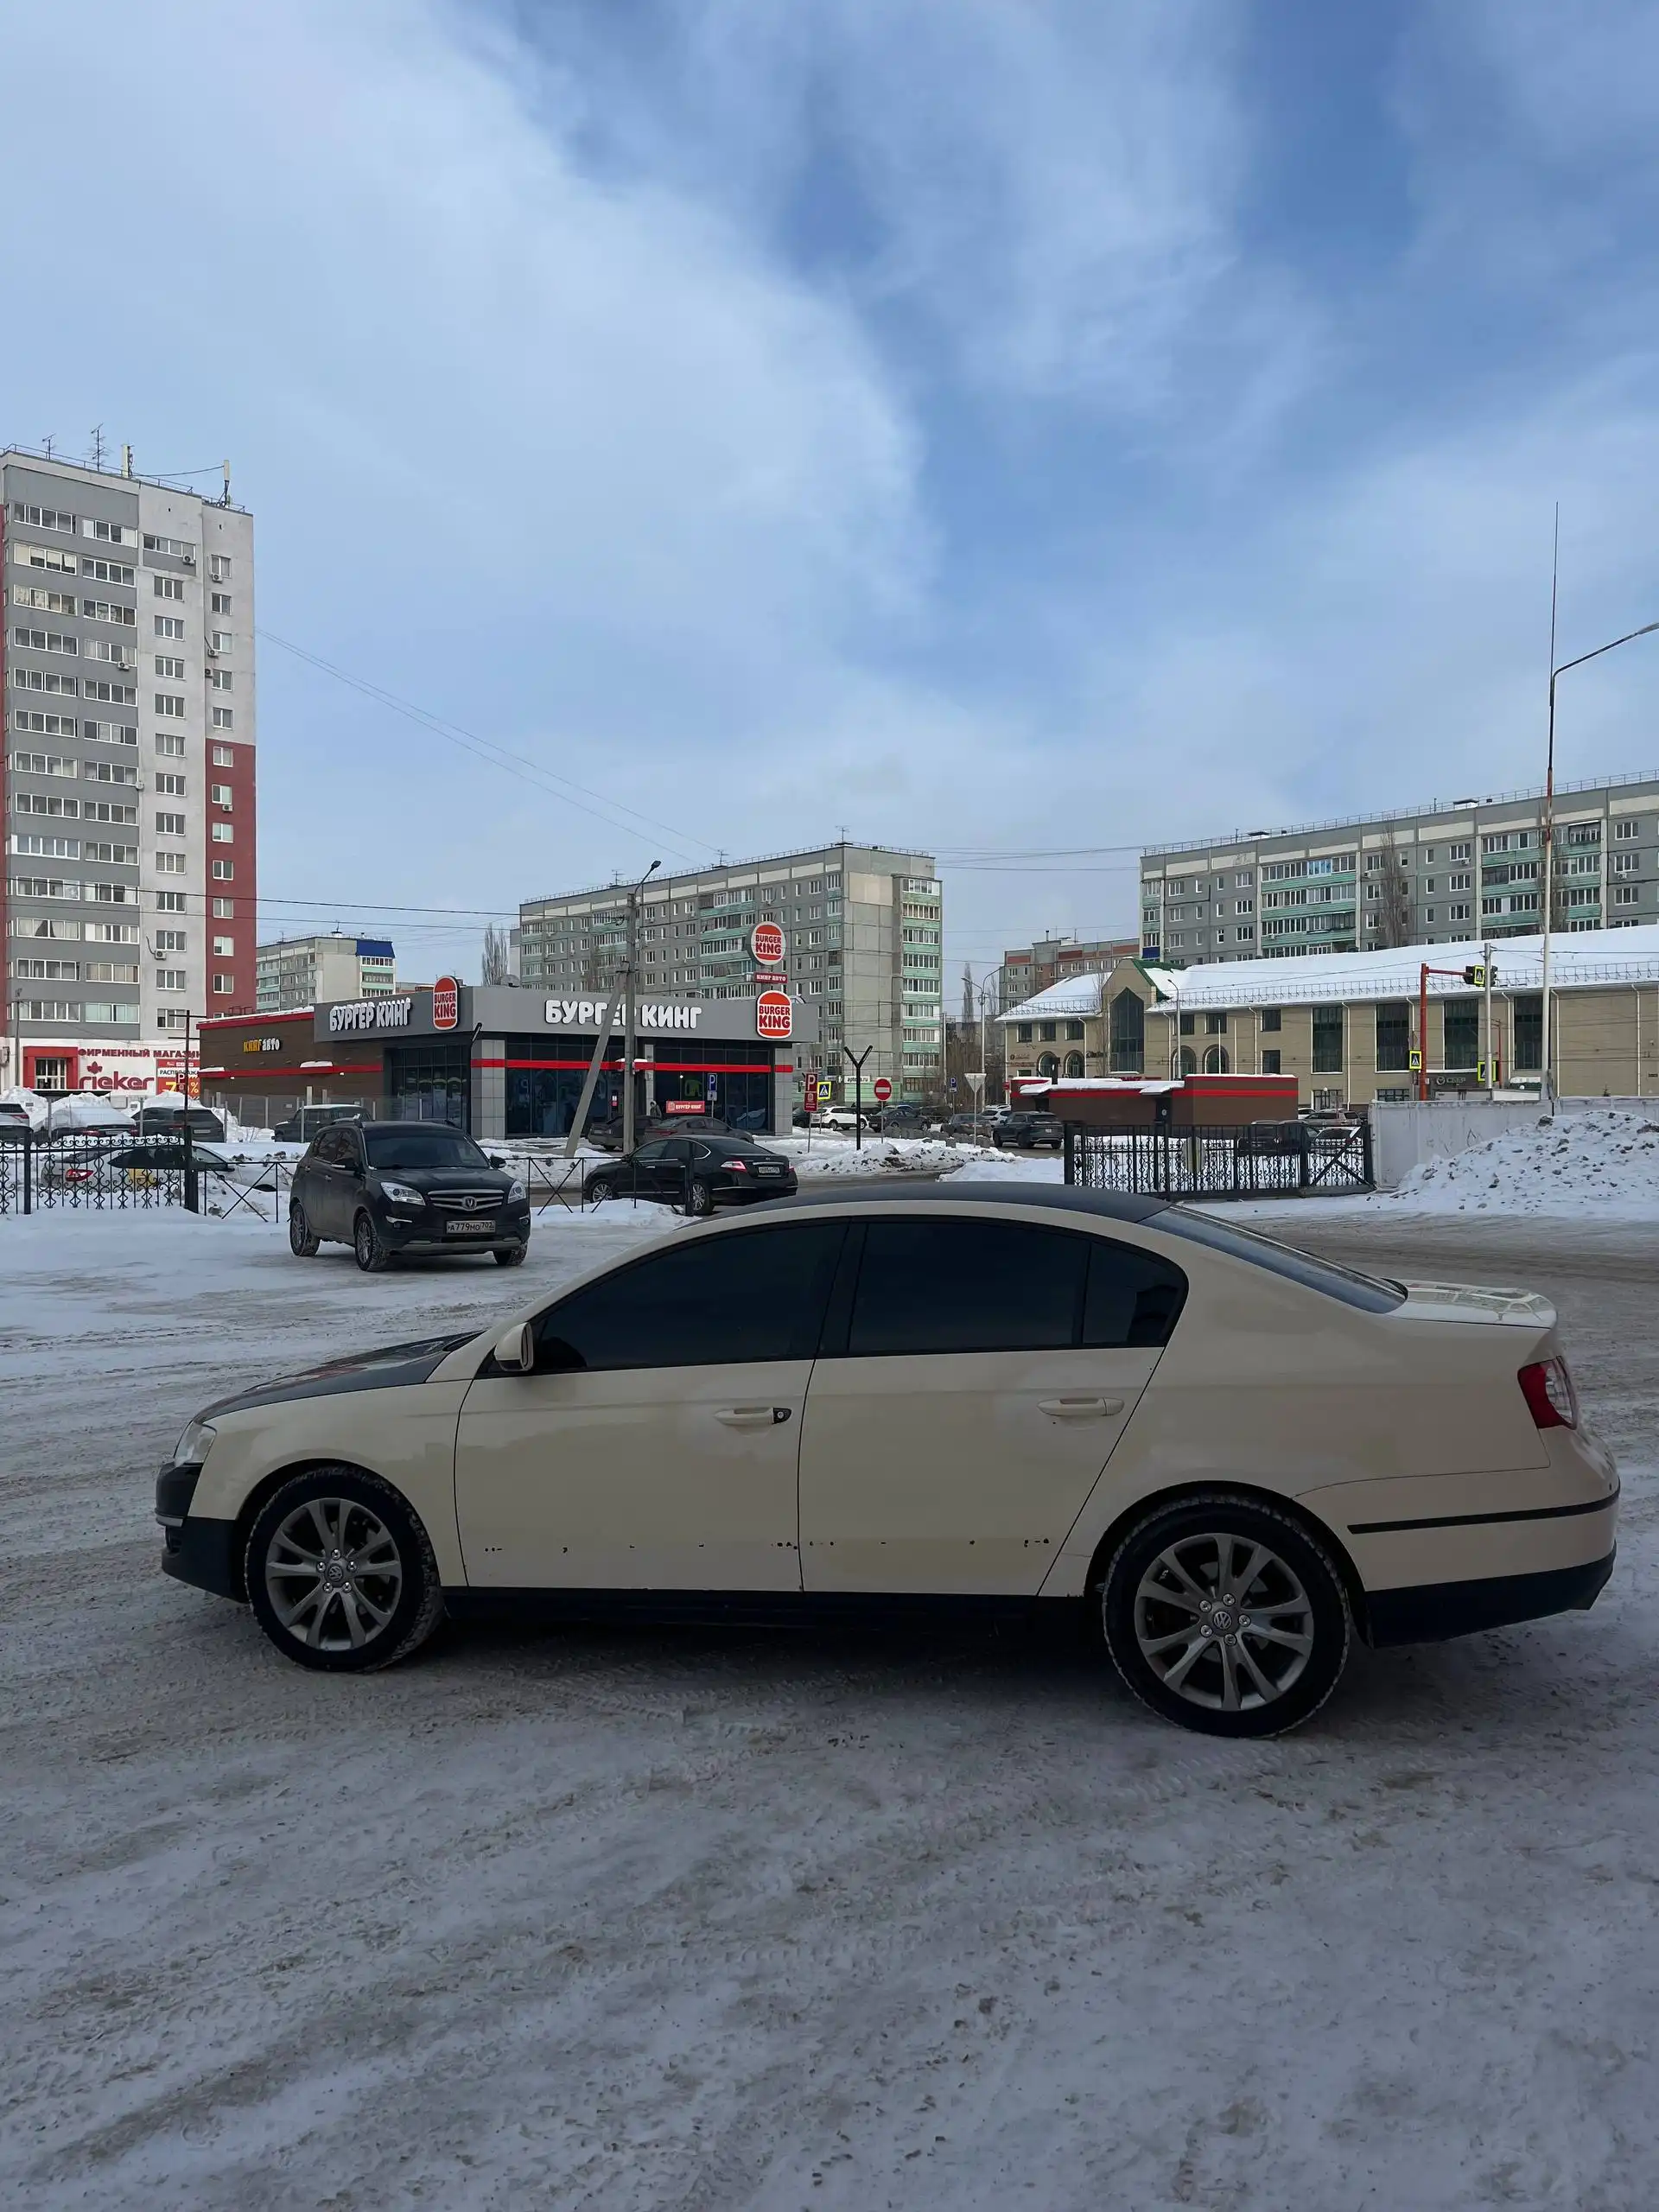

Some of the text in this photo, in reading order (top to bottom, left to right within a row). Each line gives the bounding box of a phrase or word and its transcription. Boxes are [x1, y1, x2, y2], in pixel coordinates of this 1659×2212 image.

[755, 934, 782, 944] BURGER
[755, 944, 782, 955] KING
[434, 993, 456, 1004] BURGER
[329, 996, 411, 1032] БУРГЕР КИНГ
[434, 1002, 456, 1018] KING
[641, 1004, 702, 1029] КИНГ
[759, 1005, 791, 1016] BURGER
[759, 1014, 791, 1029] KING
[78, 1048, 150, 1058] ФИРМЕННЫЙ
[79, 1071, 155, 1090] rieker
[709, 1074, 715, 1090] P
[807, 1074, 816, 1091] P
